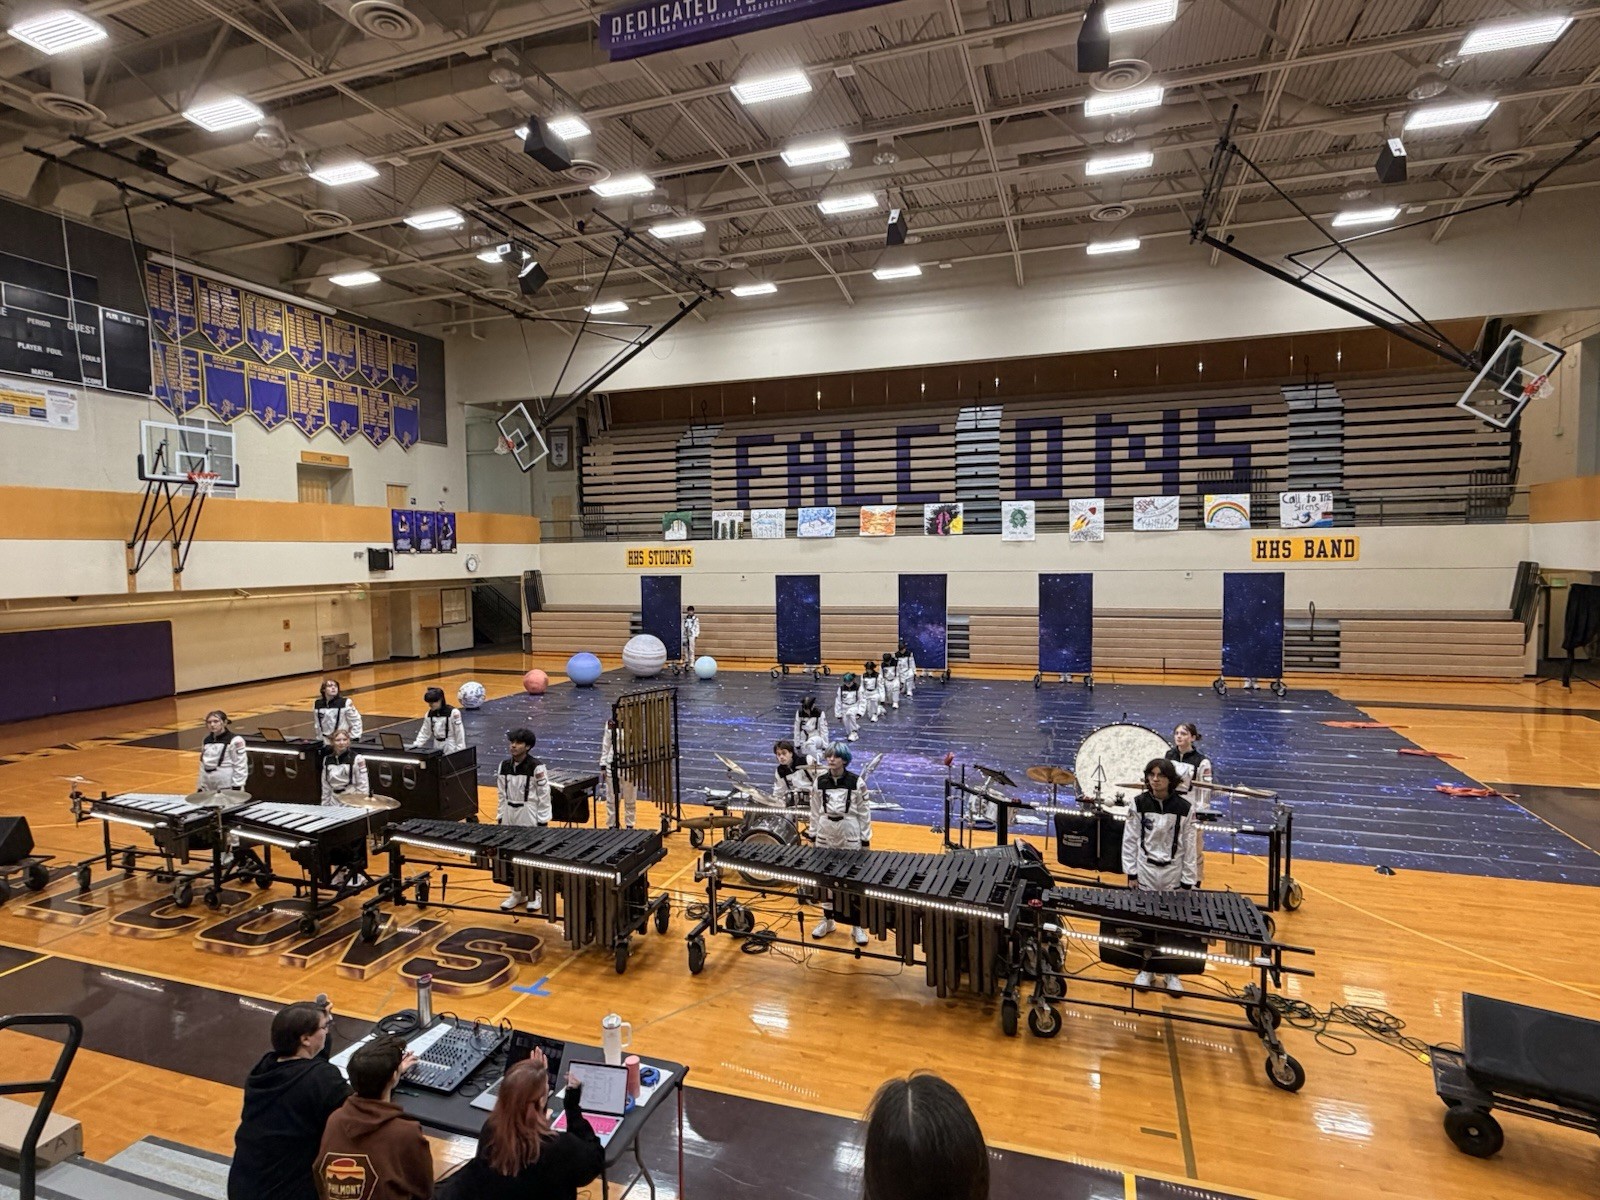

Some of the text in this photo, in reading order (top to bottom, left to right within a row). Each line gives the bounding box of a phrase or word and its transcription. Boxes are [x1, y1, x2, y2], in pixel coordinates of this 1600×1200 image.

[710, 8, 743, 21] SCHOOL
[747, 0, 797, 12] ASSOCIA
[611, 0, 717, 36] DEDICATED
[26, 317, 51, 328] PERIOD
[66, 321, 96, 335] GUEST
[17, 342, 63, 356] PLAYER FOUL
[81, 354, 101, 363] FOULS
[30, 368, 54, 377] MATCH
[1282, 492, 1333, 505] Call to THE
[1256, 539, 1355, 559] HHS BAND
[628, 549, 692, 565] HHS STUDENTS
